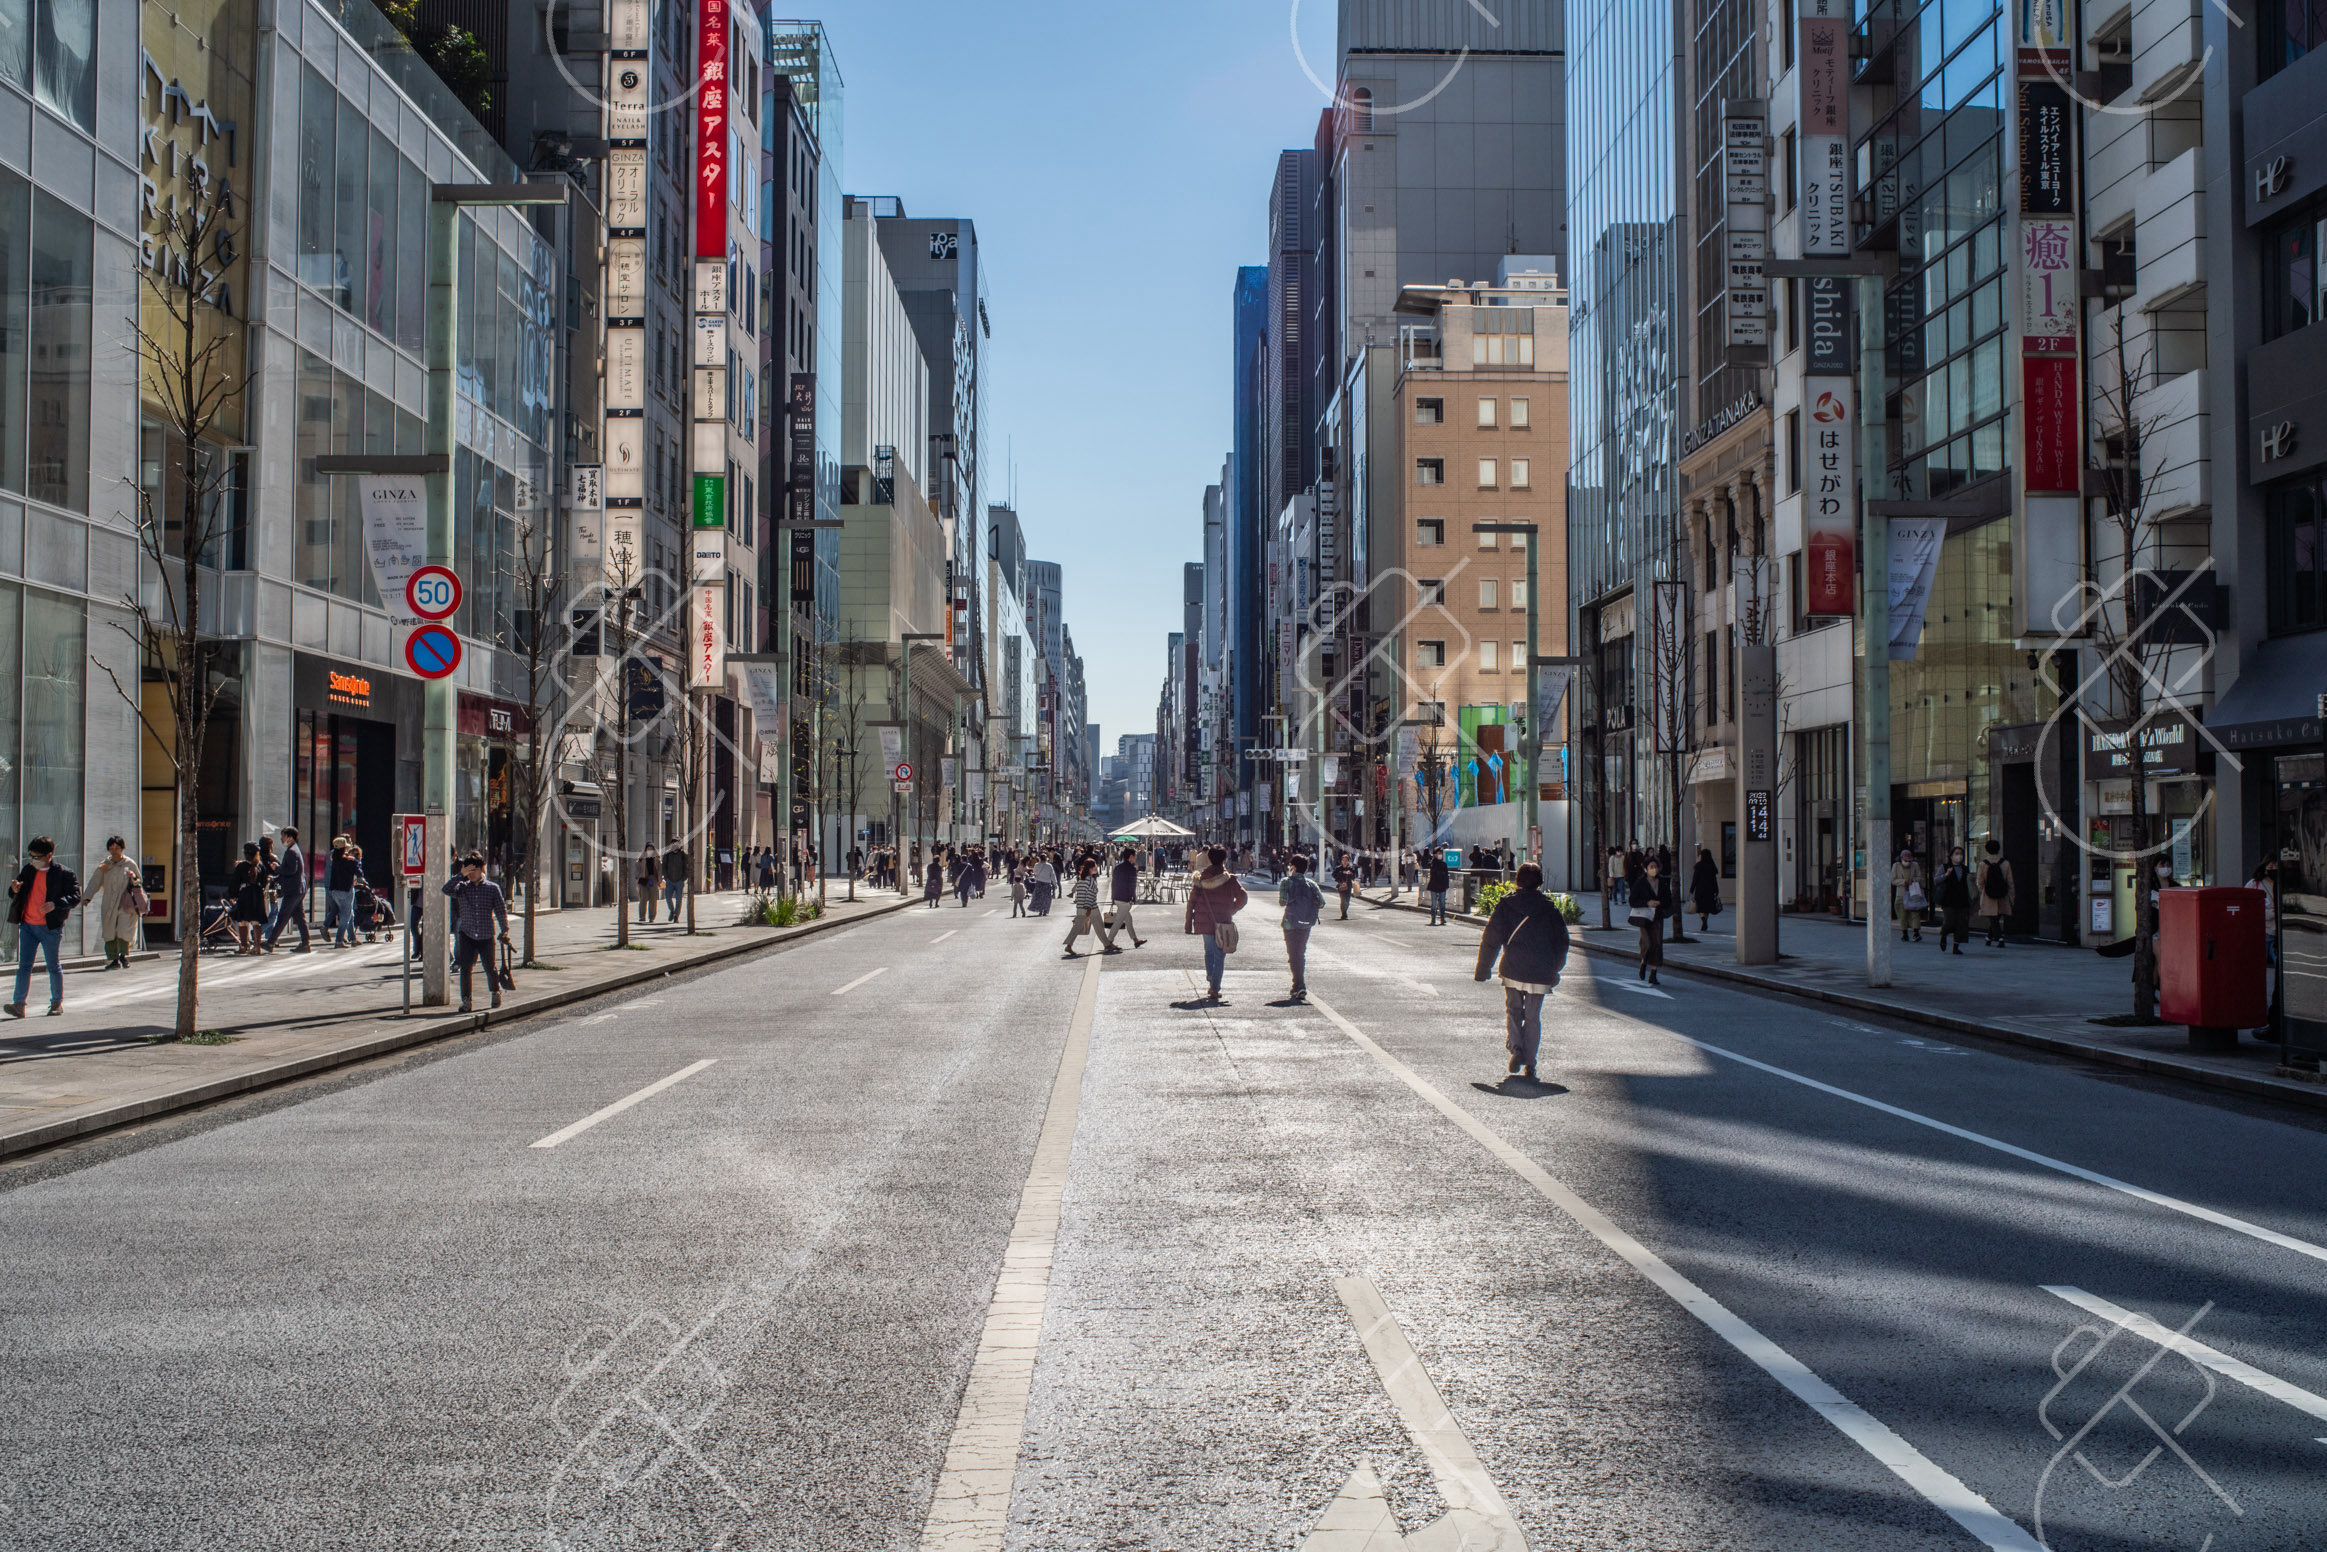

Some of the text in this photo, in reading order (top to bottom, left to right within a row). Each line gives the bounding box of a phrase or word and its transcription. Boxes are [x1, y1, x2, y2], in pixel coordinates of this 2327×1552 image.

[1812, 46, 1835, 56] Motif
[612, 100, 645, 111] Terra
[1812, 69, 1822, 116] クリニック
[1825, 59, 1837, 127] モティーフ銀座
[2019, 82, 2031, 112] Nail
[611, 153, 645, 162] GINZA
[702, 60, 724, 209] 銀座アスター
[2039, 106, 2050, 190] ネイルスクール東京
[617, 167, 627, 224] クリニック
[629, 167, 639, 213] オーラル
[1807, 182, 1821, 247] クリニック
[2024, 223, 2070, 271] 癒
[699, 290, 710, 310] ホール
[711, 265, 722, 310] 銀座アスター
[1812, 277, 1843, 357] shida
[2037, 338, 2060, 351] 2F
[624, 337, 633, 400] ULTIMATE
[1683, 390, 1755, 454] GINZA TANAKA
[2053, 362, 2065, 489] HANDA Watch World
[371, 489, 417, 500] GINZA
[577, 474, 587, 503] 七福神
[1819, 430, 1841, 515] はせがわ
[614, 515, 633, 565] 一穂堂
[1897, 528, 1936, 538] GINZA
[418, 580, 450, 605] 50
[1824, 549, 1837, 595] 銀座本店
[702, 589, 714, 683] 中国名菜 銀座アスター
[1606, 703, 1627, 730] POLA
[2230, 724, 2293, 744] Hatsuko
